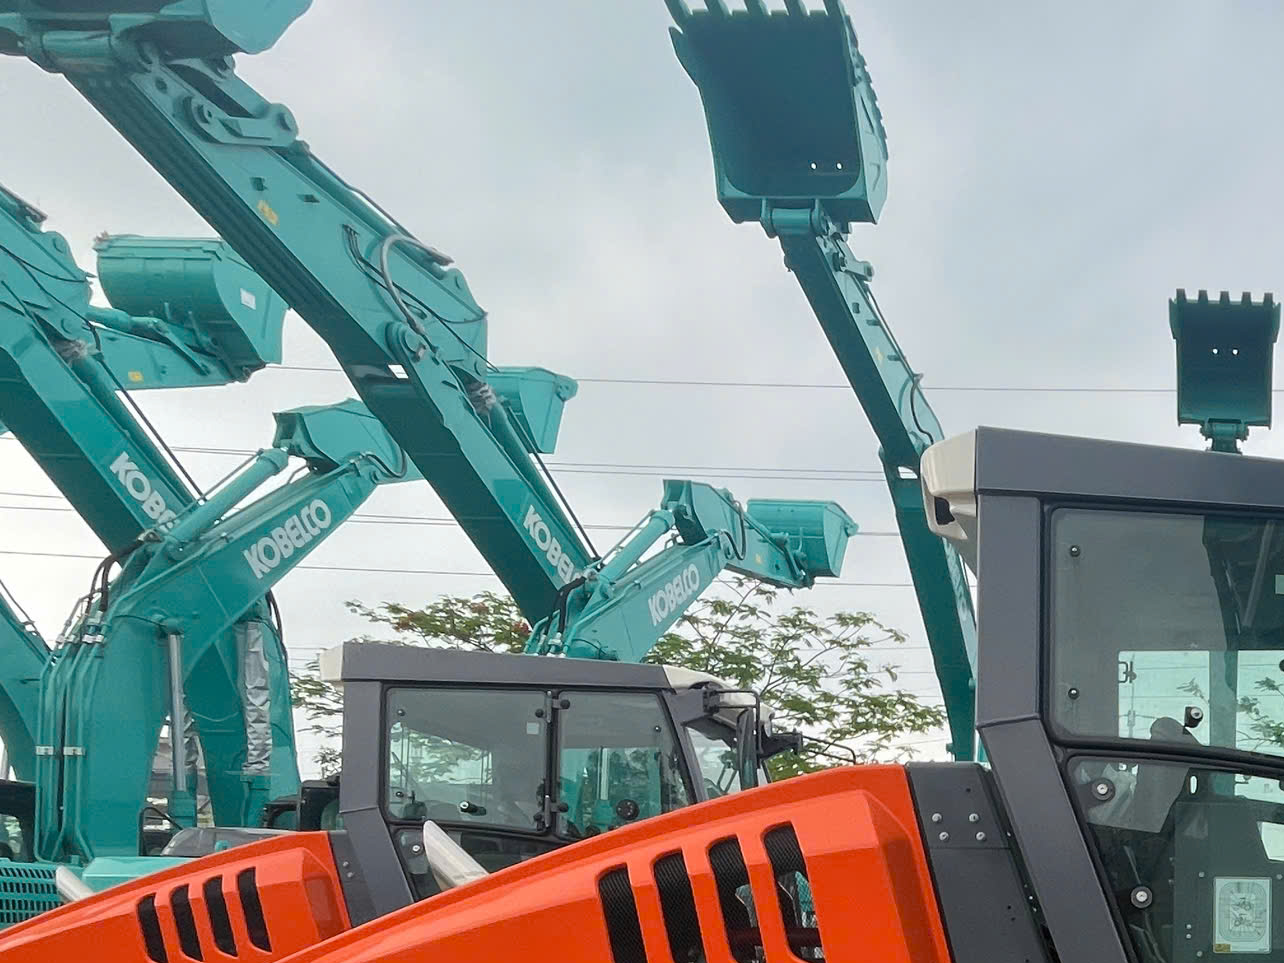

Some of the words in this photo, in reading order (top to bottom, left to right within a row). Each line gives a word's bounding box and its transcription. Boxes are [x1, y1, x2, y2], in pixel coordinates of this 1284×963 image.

[243, 499, 331, 579] KOBELCO
[523, 504, 584, 584] KOBE
[648, 563, 699, 627] KOBELCO
